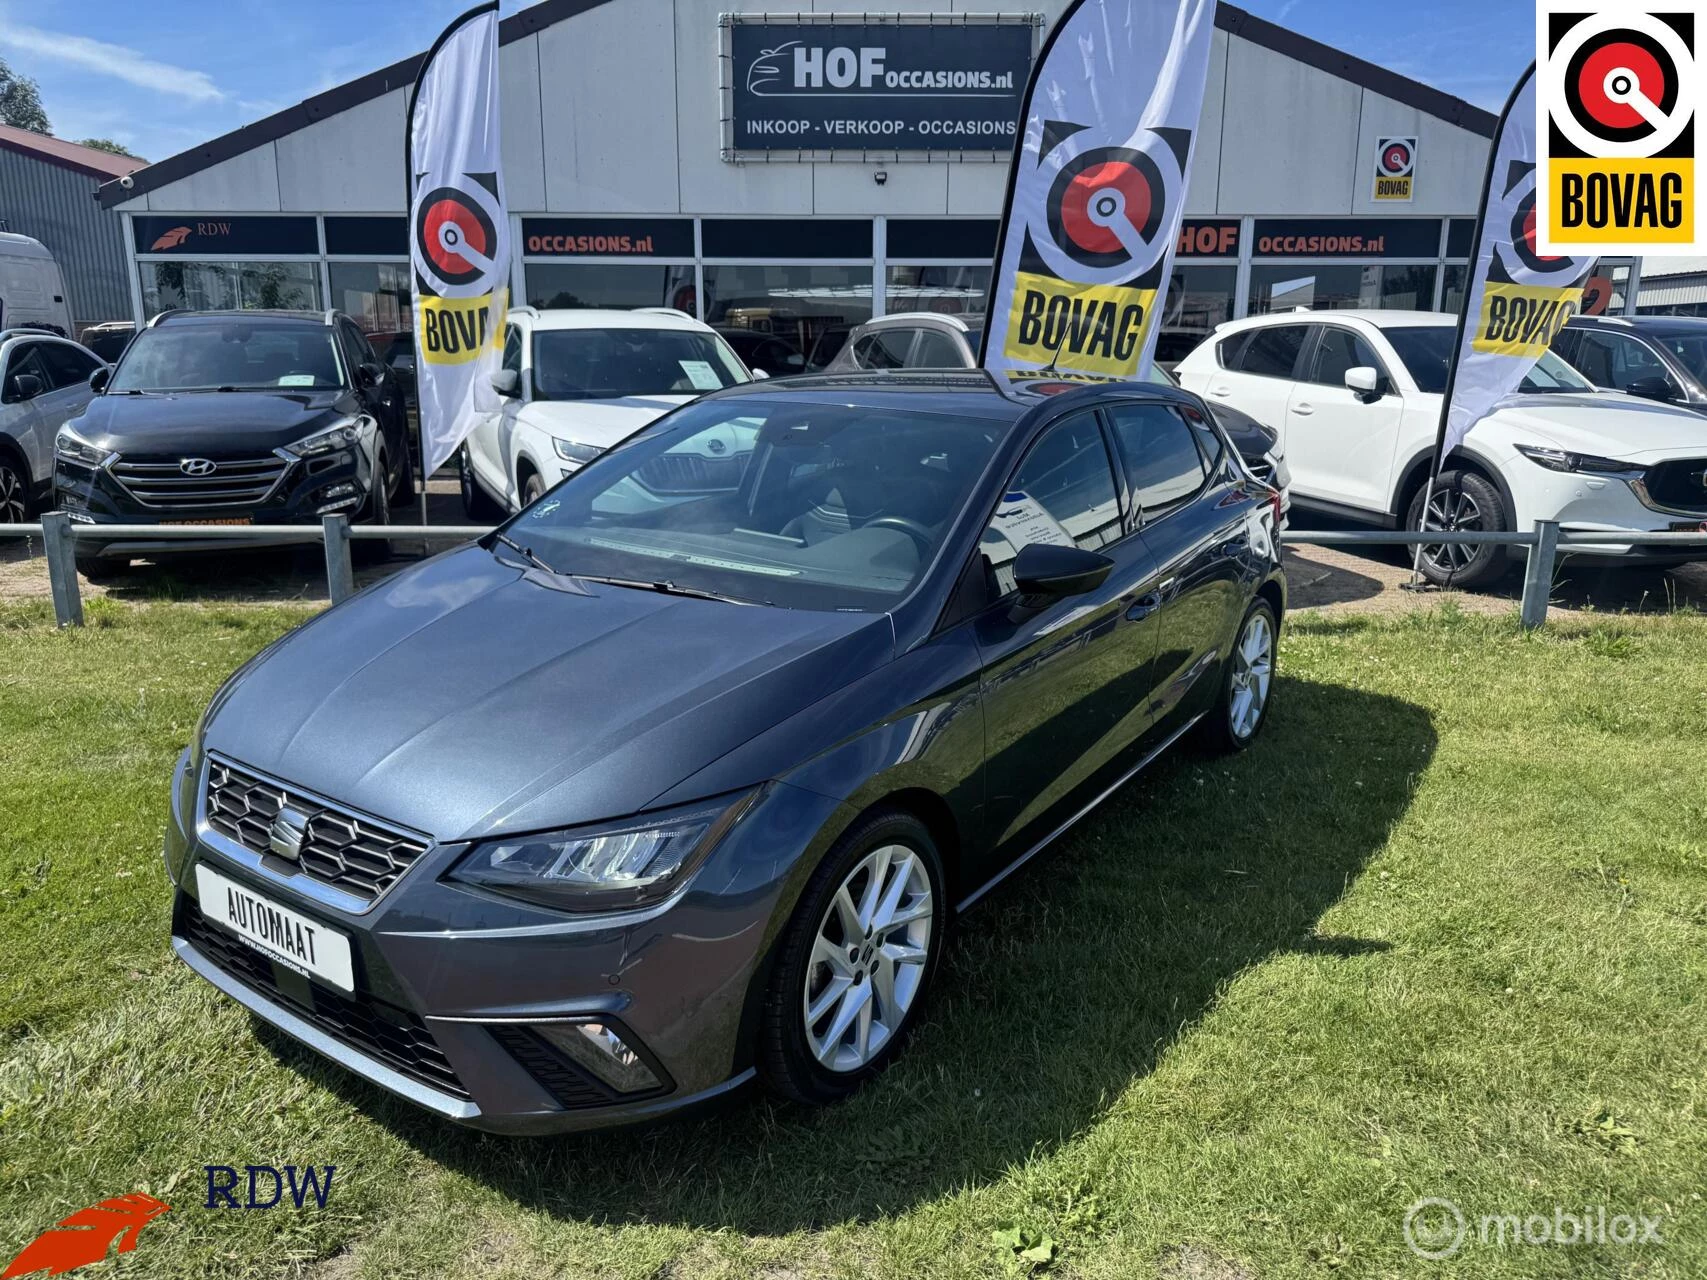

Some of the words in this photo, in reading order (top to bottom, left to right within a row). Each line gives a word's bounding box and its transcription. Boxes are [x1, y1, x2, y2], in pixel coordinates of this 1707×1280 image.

[746, 120, 810, 134] INKOOP
[824, 120, 905, 135] VERKOOP
[918, 120, 1016, 135] OCCASIONS
[1377, 180, 1409, 196] BOVAG
[197, 223, 232, 236] RDW
[528, 236, 653, 252] OCCASIONS.nl
[1177, 226, 1238, 253] HOF
[1258, 236, 1384, 252] OCCASIONS.nl
[1018, 289, 1144, 362] BOVAG
[227, 886, 316, 965] AUTOMAAT
